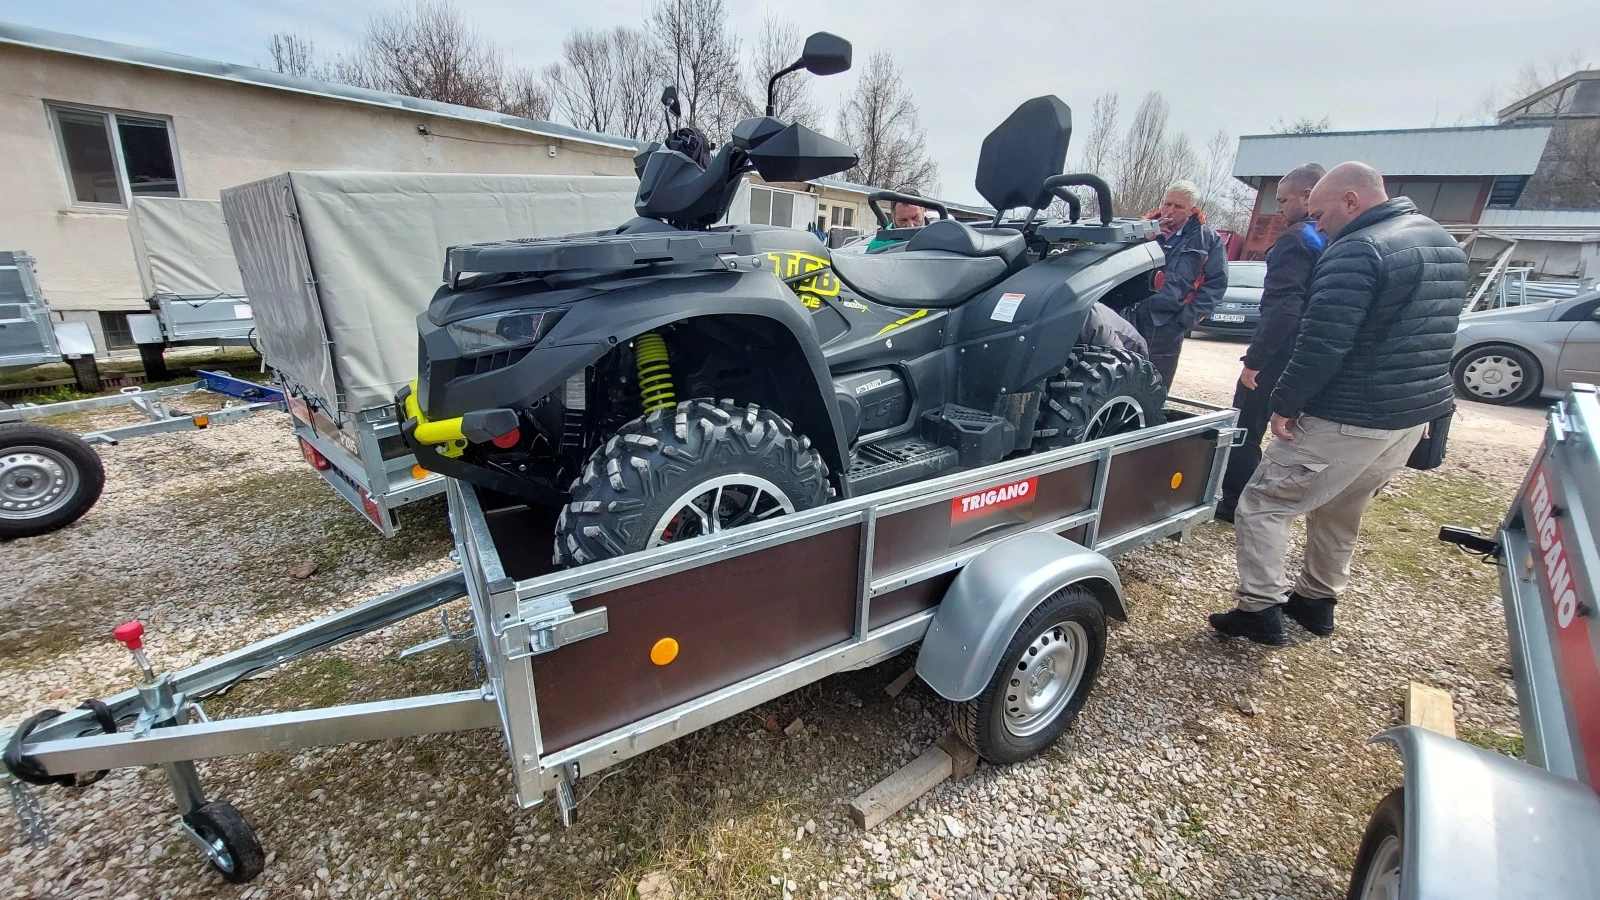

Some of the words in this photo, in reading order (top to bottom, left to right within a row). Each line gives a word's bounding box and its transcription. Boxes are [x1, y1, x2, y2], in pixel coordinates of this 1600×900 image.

[767, 250, 840, 297] TGB
[961, 481, 1029, 513] TRIGANO
[1530, 471, 1576, 629] TRIGANO
